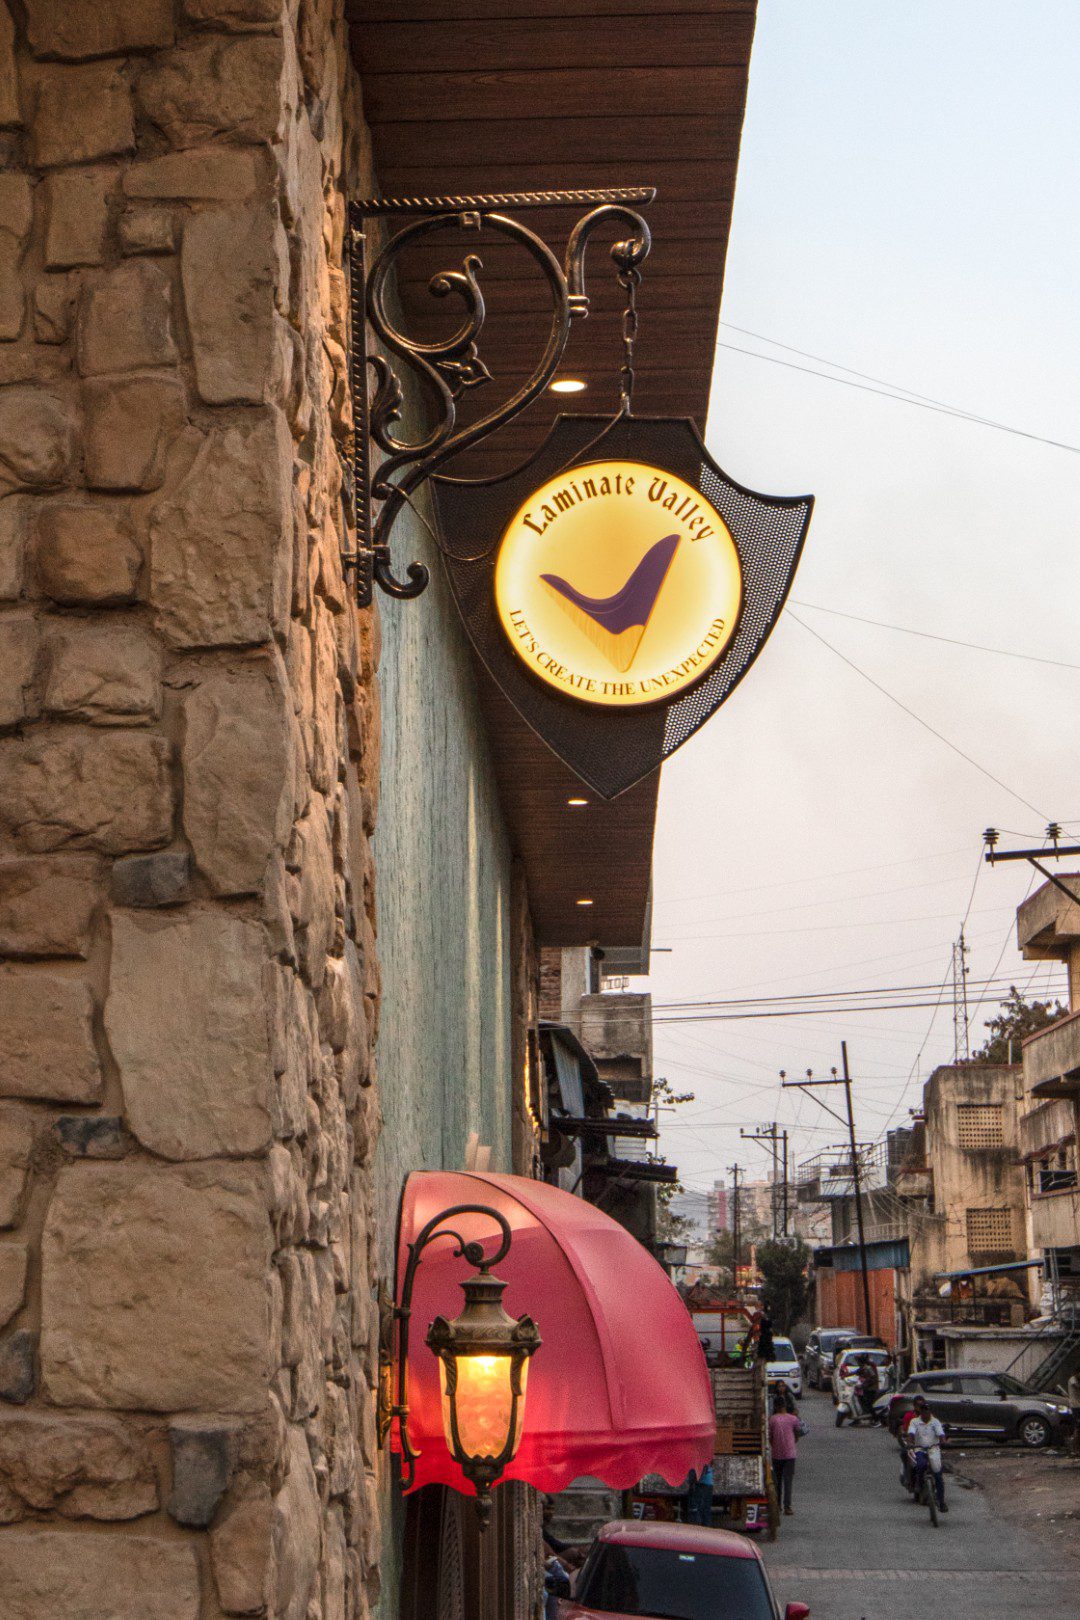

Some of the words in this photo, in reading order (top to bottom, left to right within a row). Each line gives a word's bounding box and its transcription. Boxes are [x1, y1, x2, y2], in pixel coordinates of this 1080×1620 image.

[522, 473, 635, 536] Laminate
[648, 476, 715, 542] Valley
[510, 609, 539, 653] LET'S
[536, 651, 596, 692] CREATE
[601, 681, 636, 695] THE
[640, 618, 725, 693] UNEXPECTED
